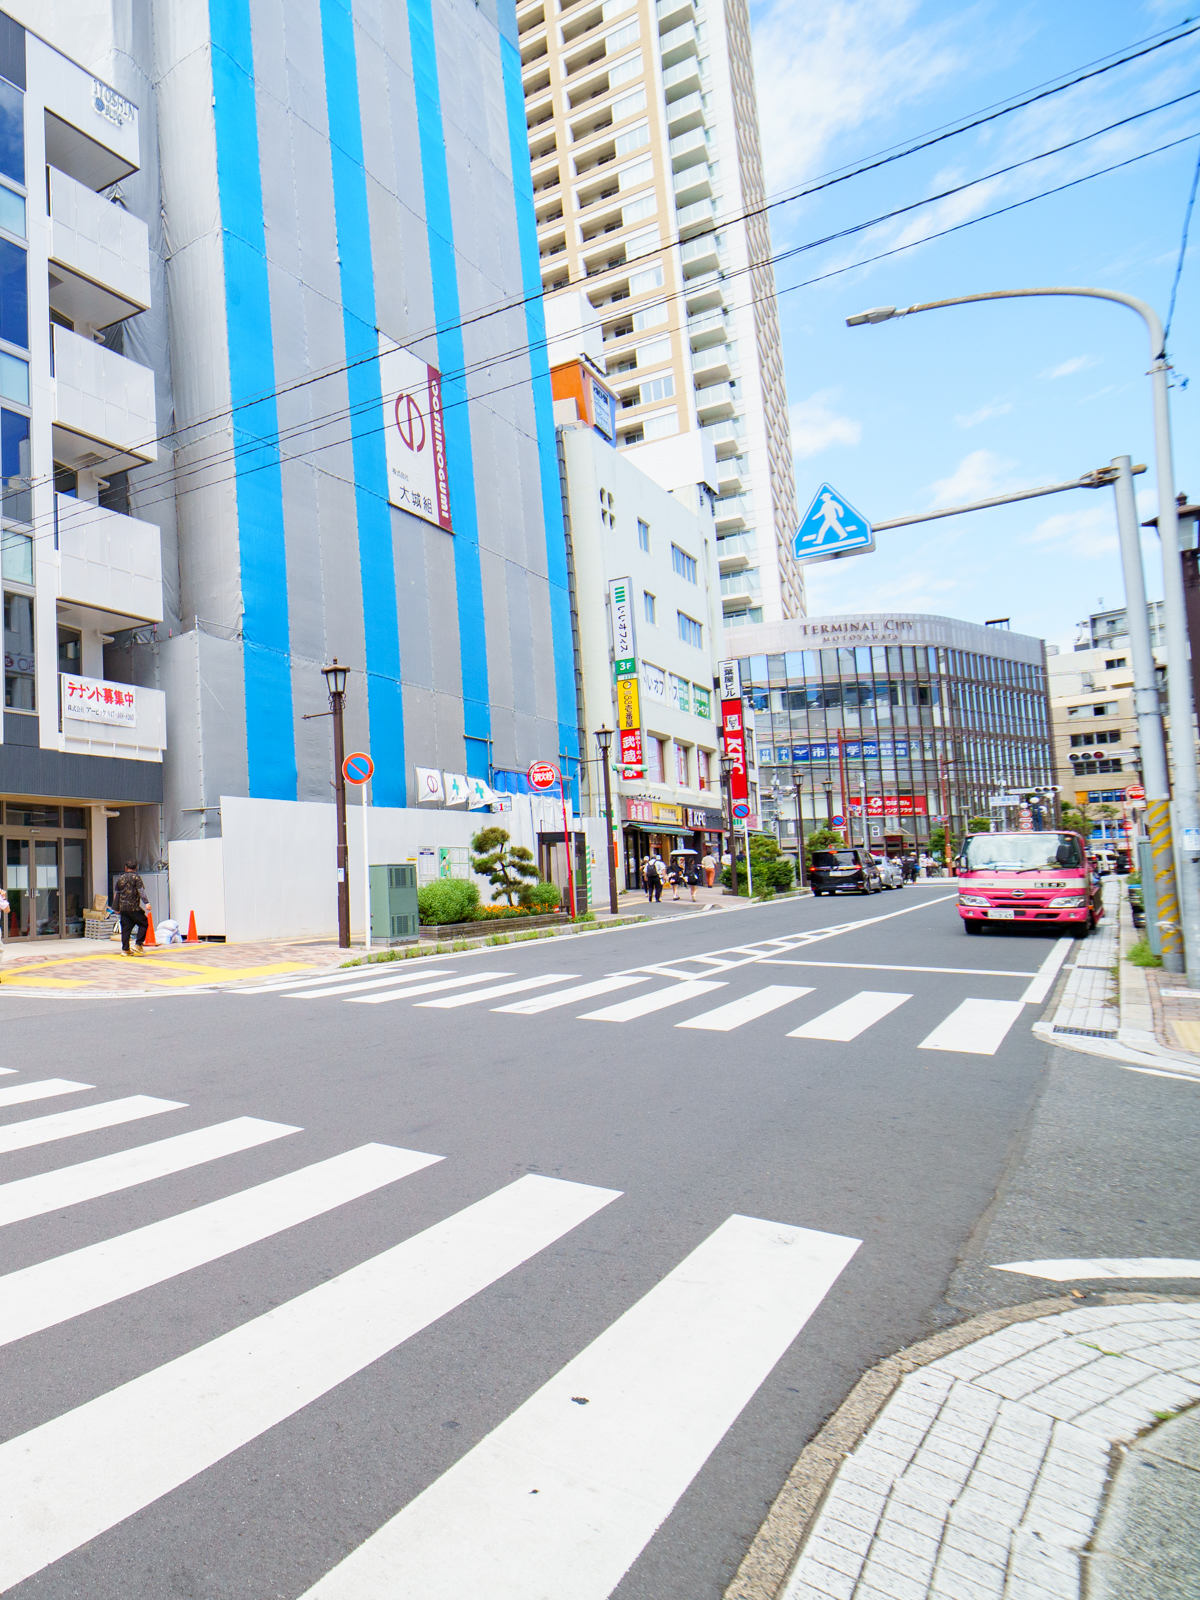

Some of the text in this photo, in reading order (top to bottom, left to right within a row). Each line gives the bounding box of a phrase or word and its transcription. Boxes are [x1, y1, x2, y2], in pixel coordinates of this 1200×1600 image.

[400, 485, 433, 515] 大城組
[800, 619, 914, 635] TERMINAL CITY
[822, 633, 899, 643] MOTOYAWATA
[620, 661, 632, 671] 3F
[68, 681, 134, 708] テナント募集中
[534, 771, 554, 782] 消火栓
[693, 811, 707, 826] KFC
